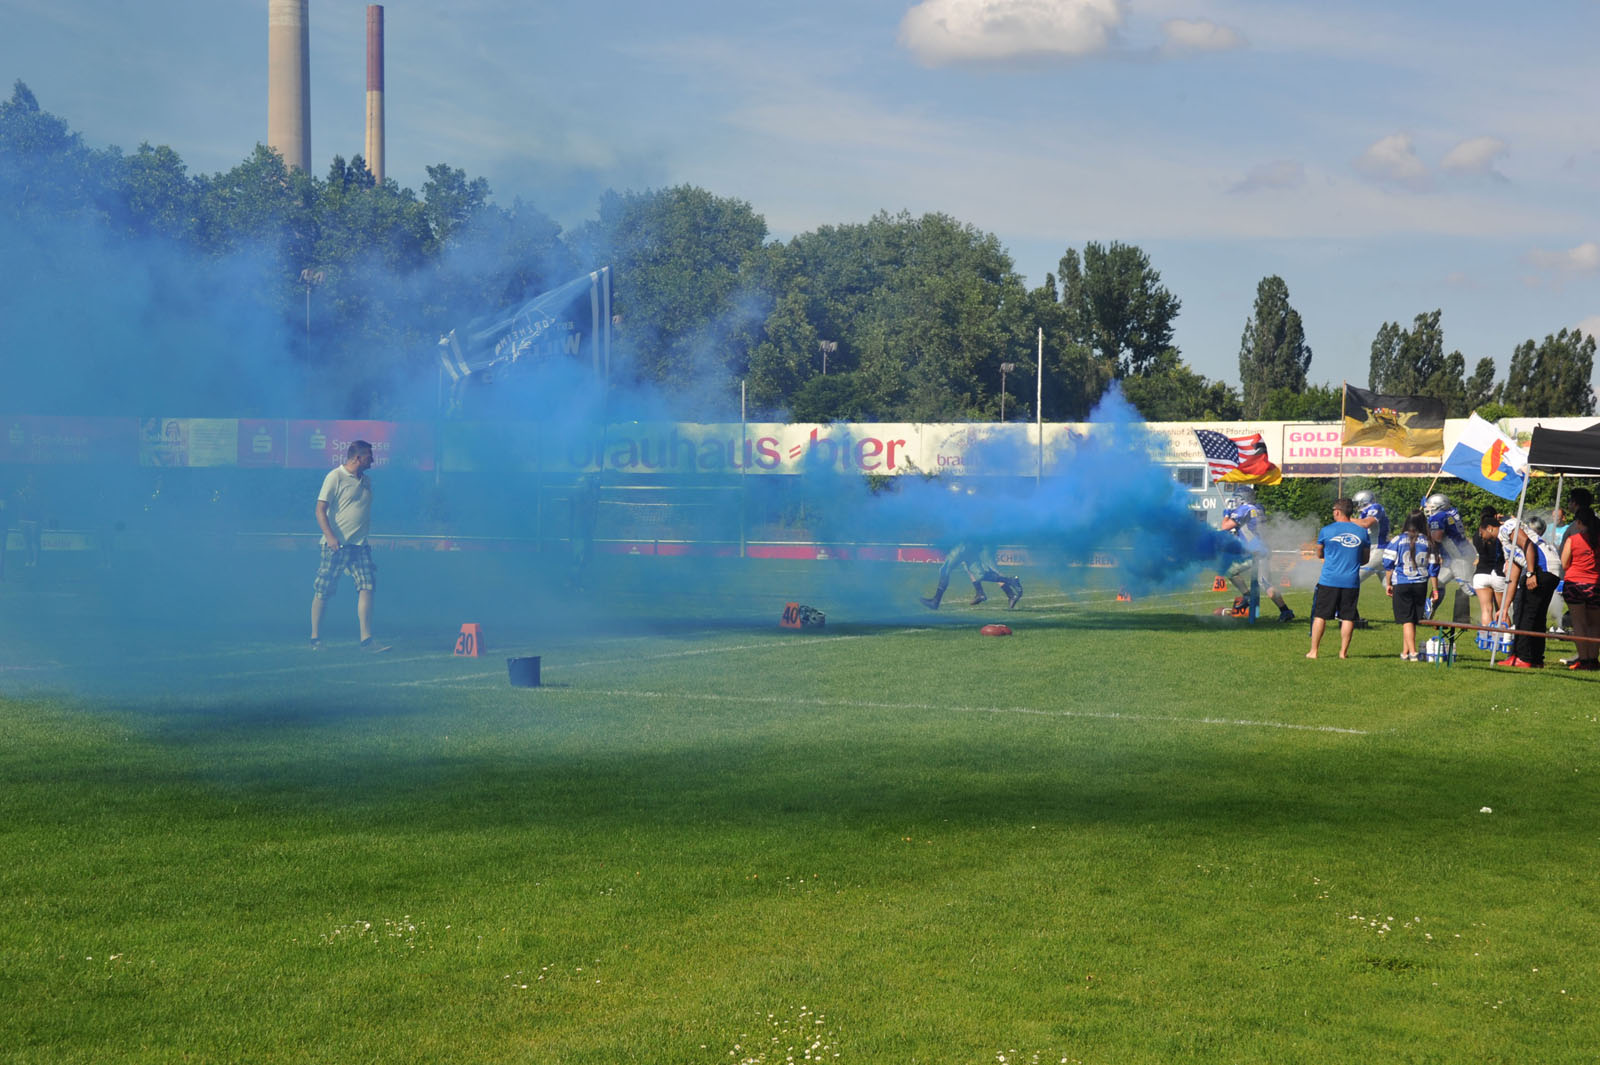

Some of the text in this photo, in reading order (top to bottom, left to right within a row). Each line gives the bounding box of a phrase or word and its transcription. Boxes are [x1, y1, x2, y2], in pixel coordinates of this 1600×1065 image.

[810, 427, 906, 471] bier
[1288, 446, 1401, 458] LINDENBER
[1202, 497, 1217, 509] ON
[1214, 578, 1225, 589] 30
[783, 606, 799, 624] 40
[456, 631, 474, 656] 30
